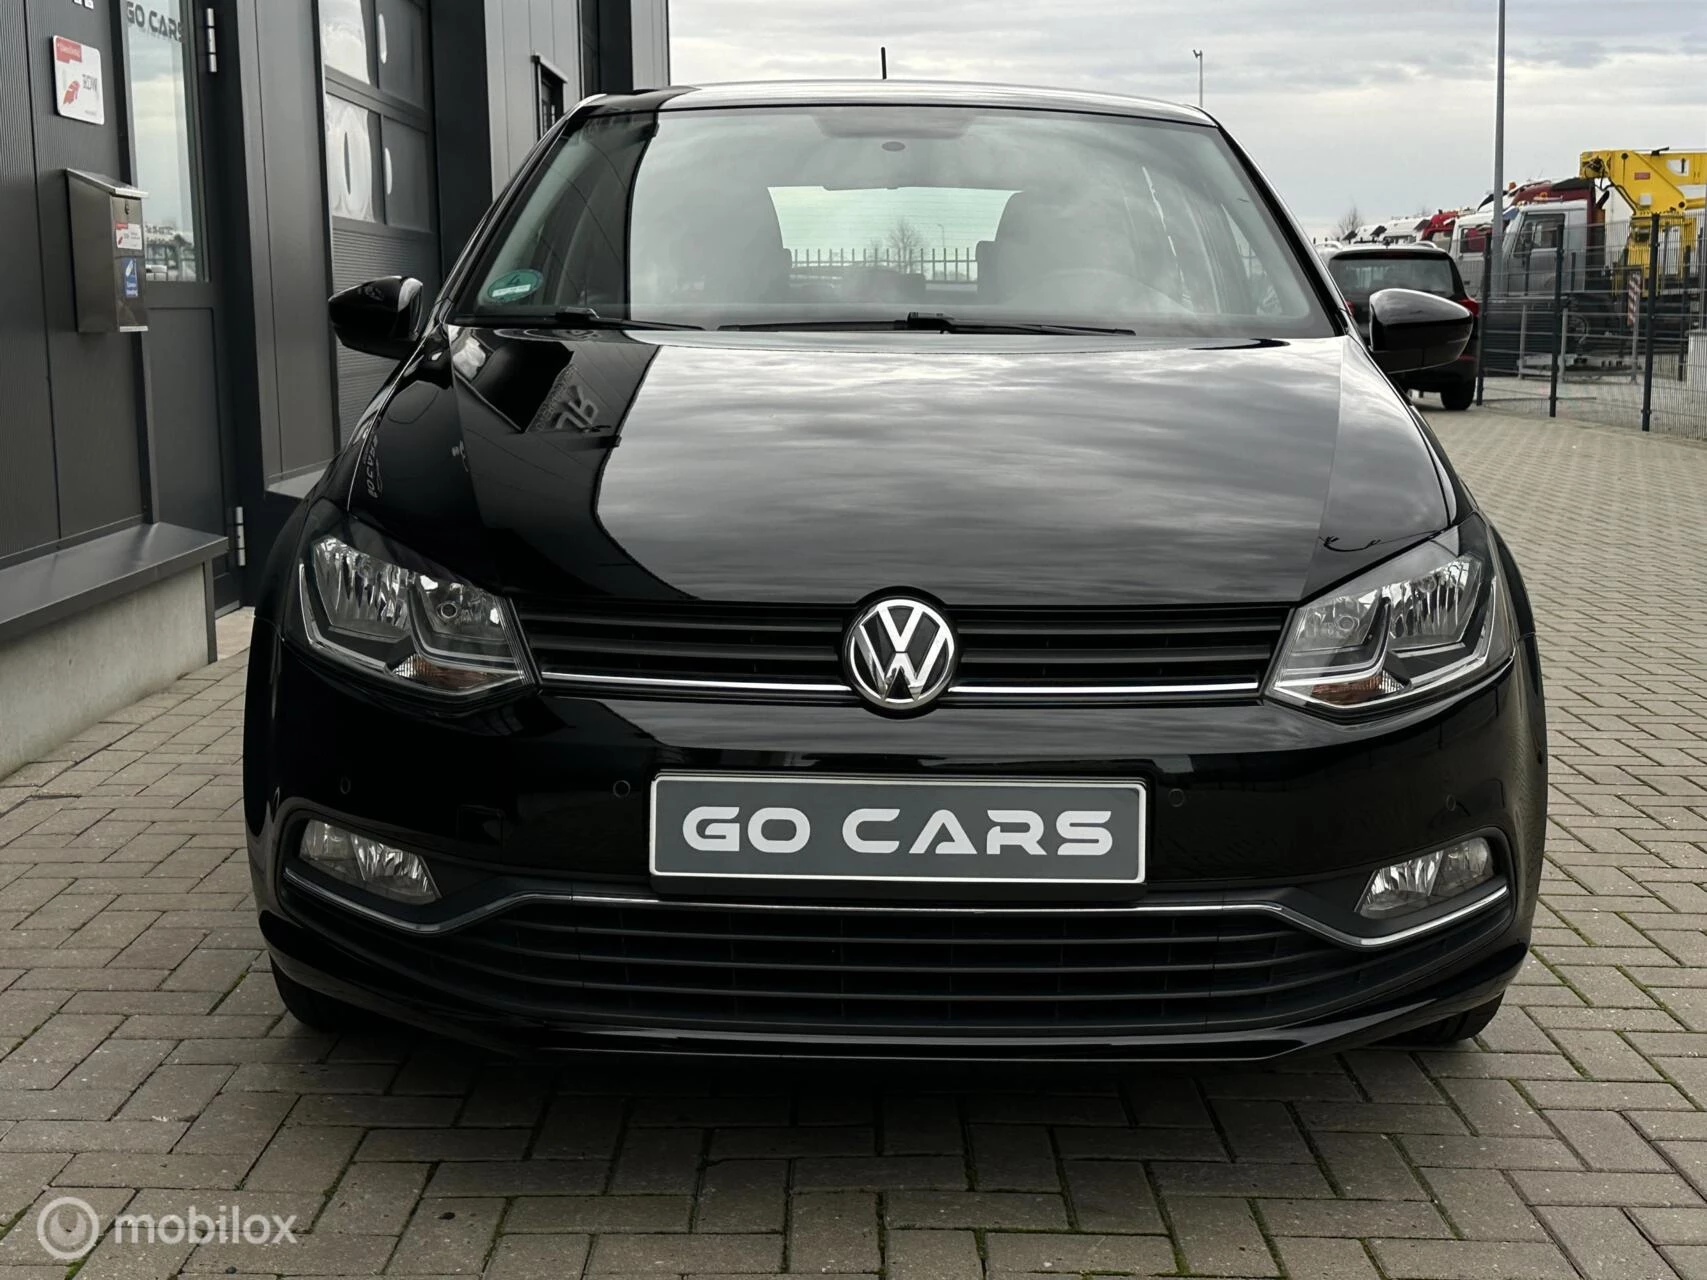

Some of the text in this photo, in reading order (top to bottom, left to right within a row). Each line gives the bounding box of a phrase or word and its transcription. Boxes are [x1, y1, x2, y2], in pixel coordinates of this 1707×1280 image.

[126, 1, 145, 28] GO
[682, 805, 1114, 856] GO CARS
